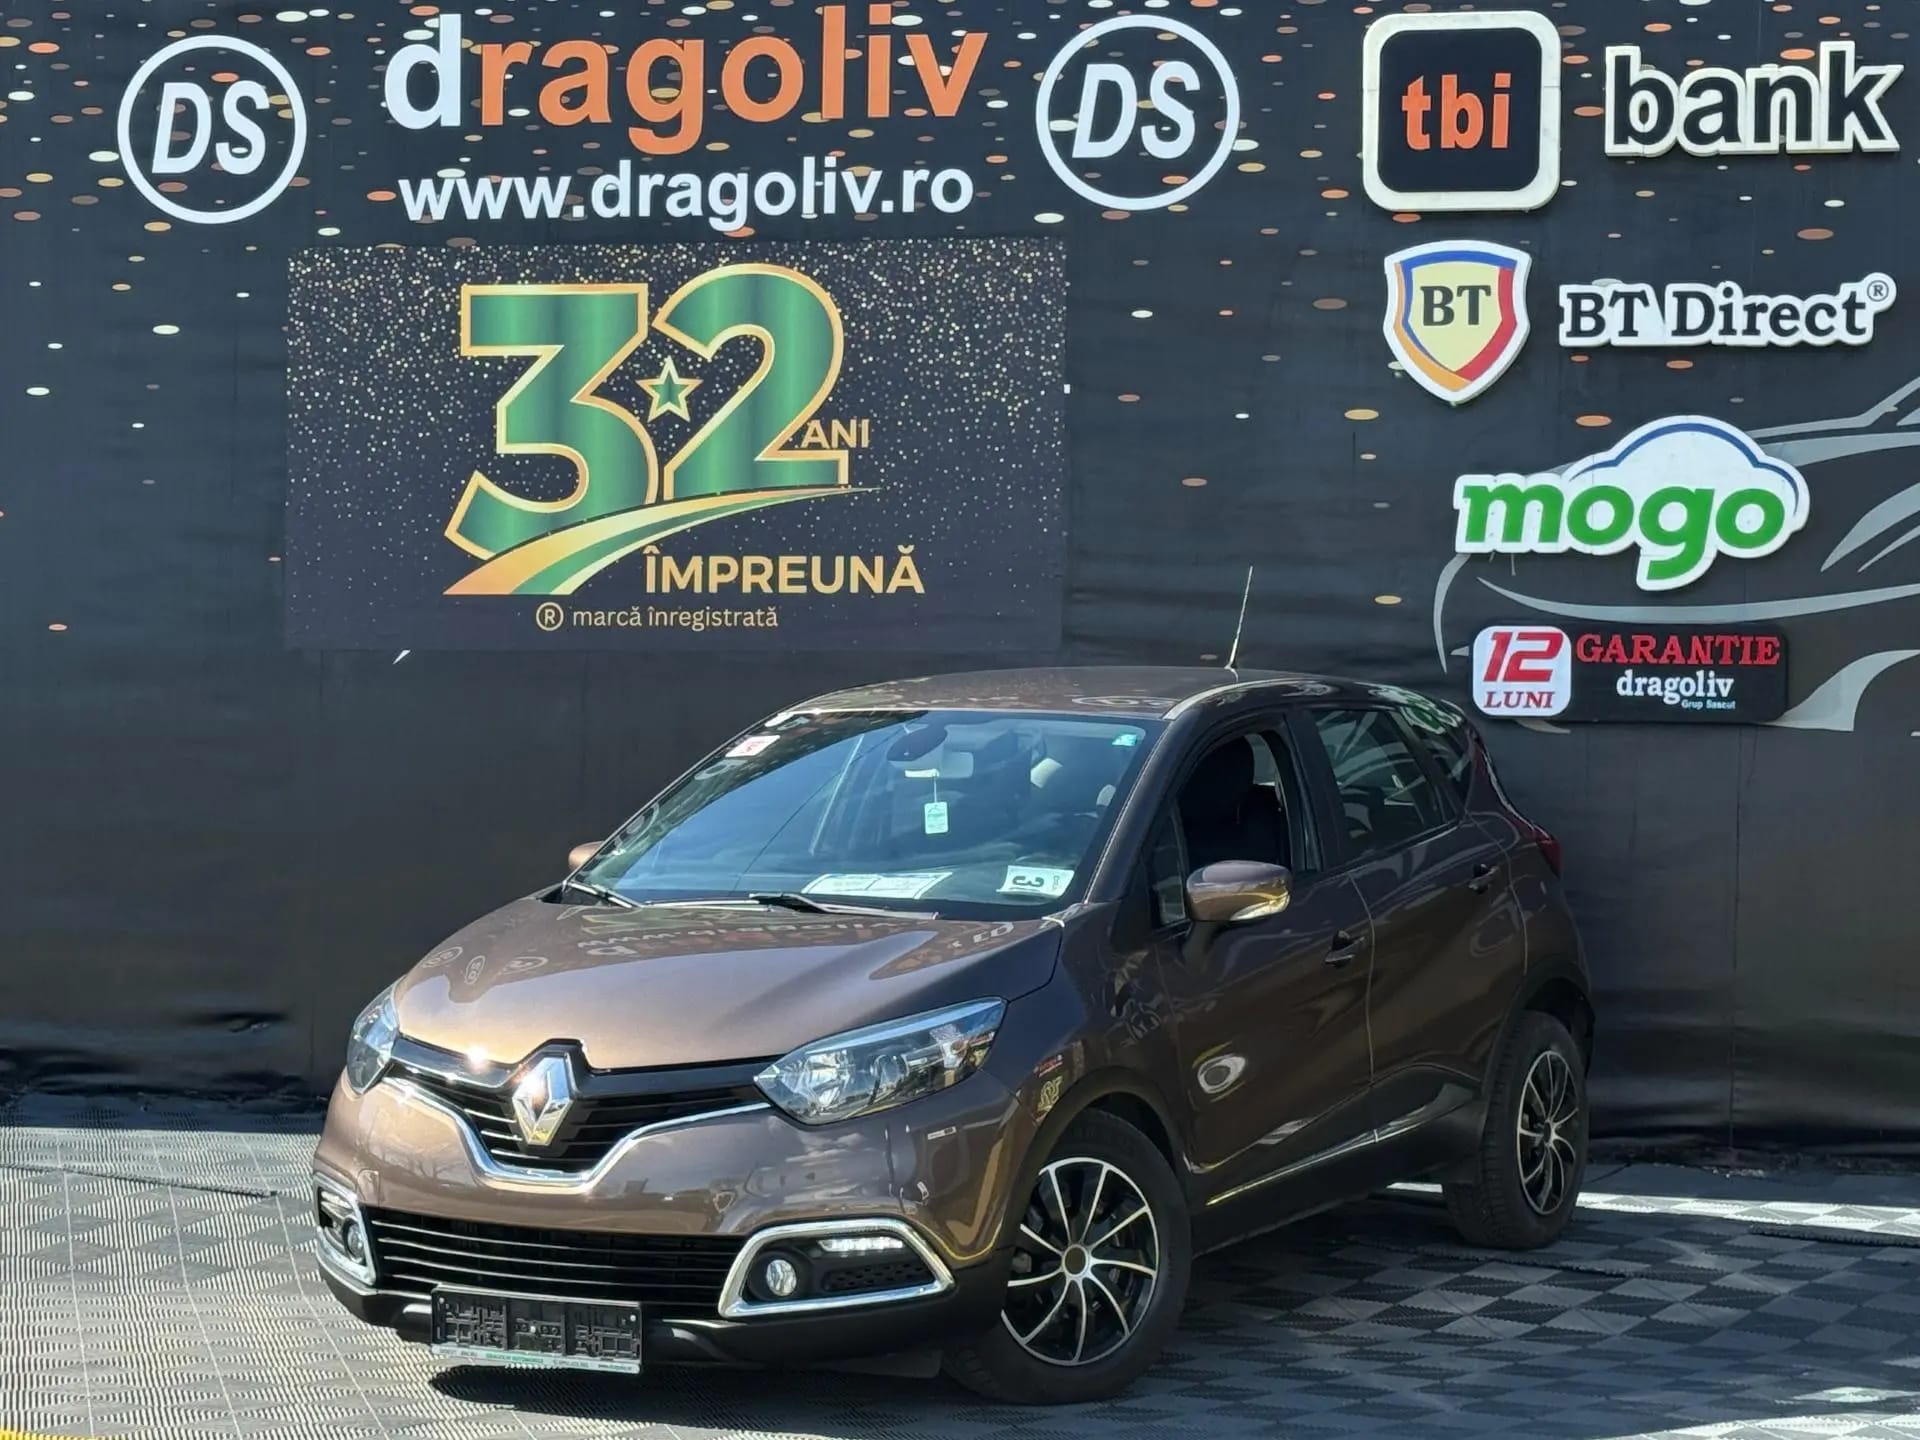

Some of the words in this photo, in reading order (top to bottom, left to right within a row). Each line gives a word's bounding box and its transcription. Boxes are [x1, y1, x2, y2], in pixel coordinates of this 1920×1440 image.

[384, 4, 989, 155] dragoliv
[1612, 48, 1891, 149] bank
[151, 79, 270, 175] DS
[1071, 60, 1201, 159] DS
[1401, 72, 1512, 150] tbi
[398, 156, 974, 233] www.dragoliv.ro
[1420, 284, 1492, 327] BT
[1565, 290, 1650, 339] BT
[443, 263, 850, 560] 32
[801, 418, 870, 449] ANI
[1462, 483, 1786, 581] mogo
[641, 545, 926, 595] ÎMPREUNĂ
[572, 605, 643, 628] marcă
[647, 605, 779, 633] înregistrată
[1482, 631, 1564, 683] 12
[1575, 633, 1781, 667] GARANTIE
[1483, 690, 1554, 709] LUNI
[1616, 669, 1736, 704] dragoliv
